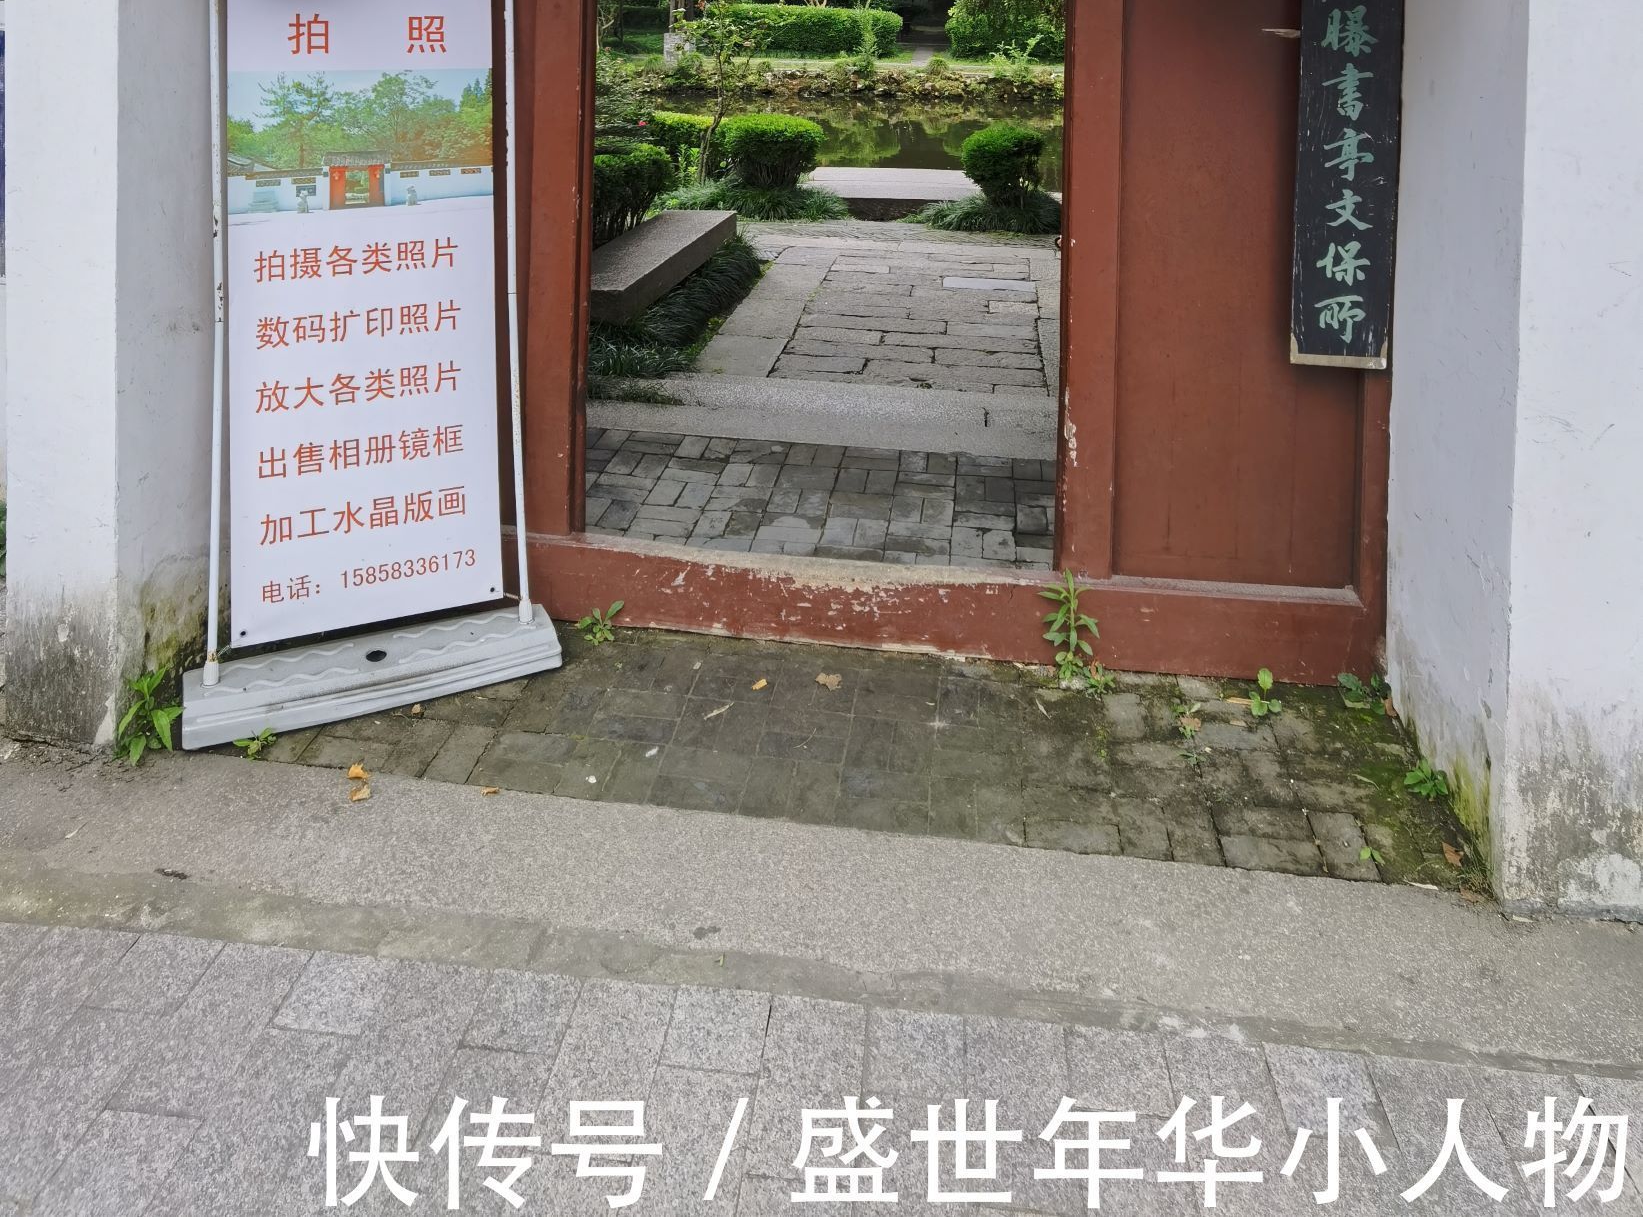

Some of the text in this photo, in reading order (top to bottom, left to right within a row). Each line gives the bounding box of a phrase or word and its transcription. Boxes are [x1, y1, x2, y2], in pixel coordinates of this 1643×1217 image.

[254, 236, 460, 284] 拍摄各类照片
[255, 299, 462, 351] 数码扩印照片
[255, 361, 462, 414] 放大各类照片
[257, 424, 465, 480] 出售相册镜框
[259, 485, 467, 546] 加工水晶版画
[340, 549, 477, 590] 15858336173
